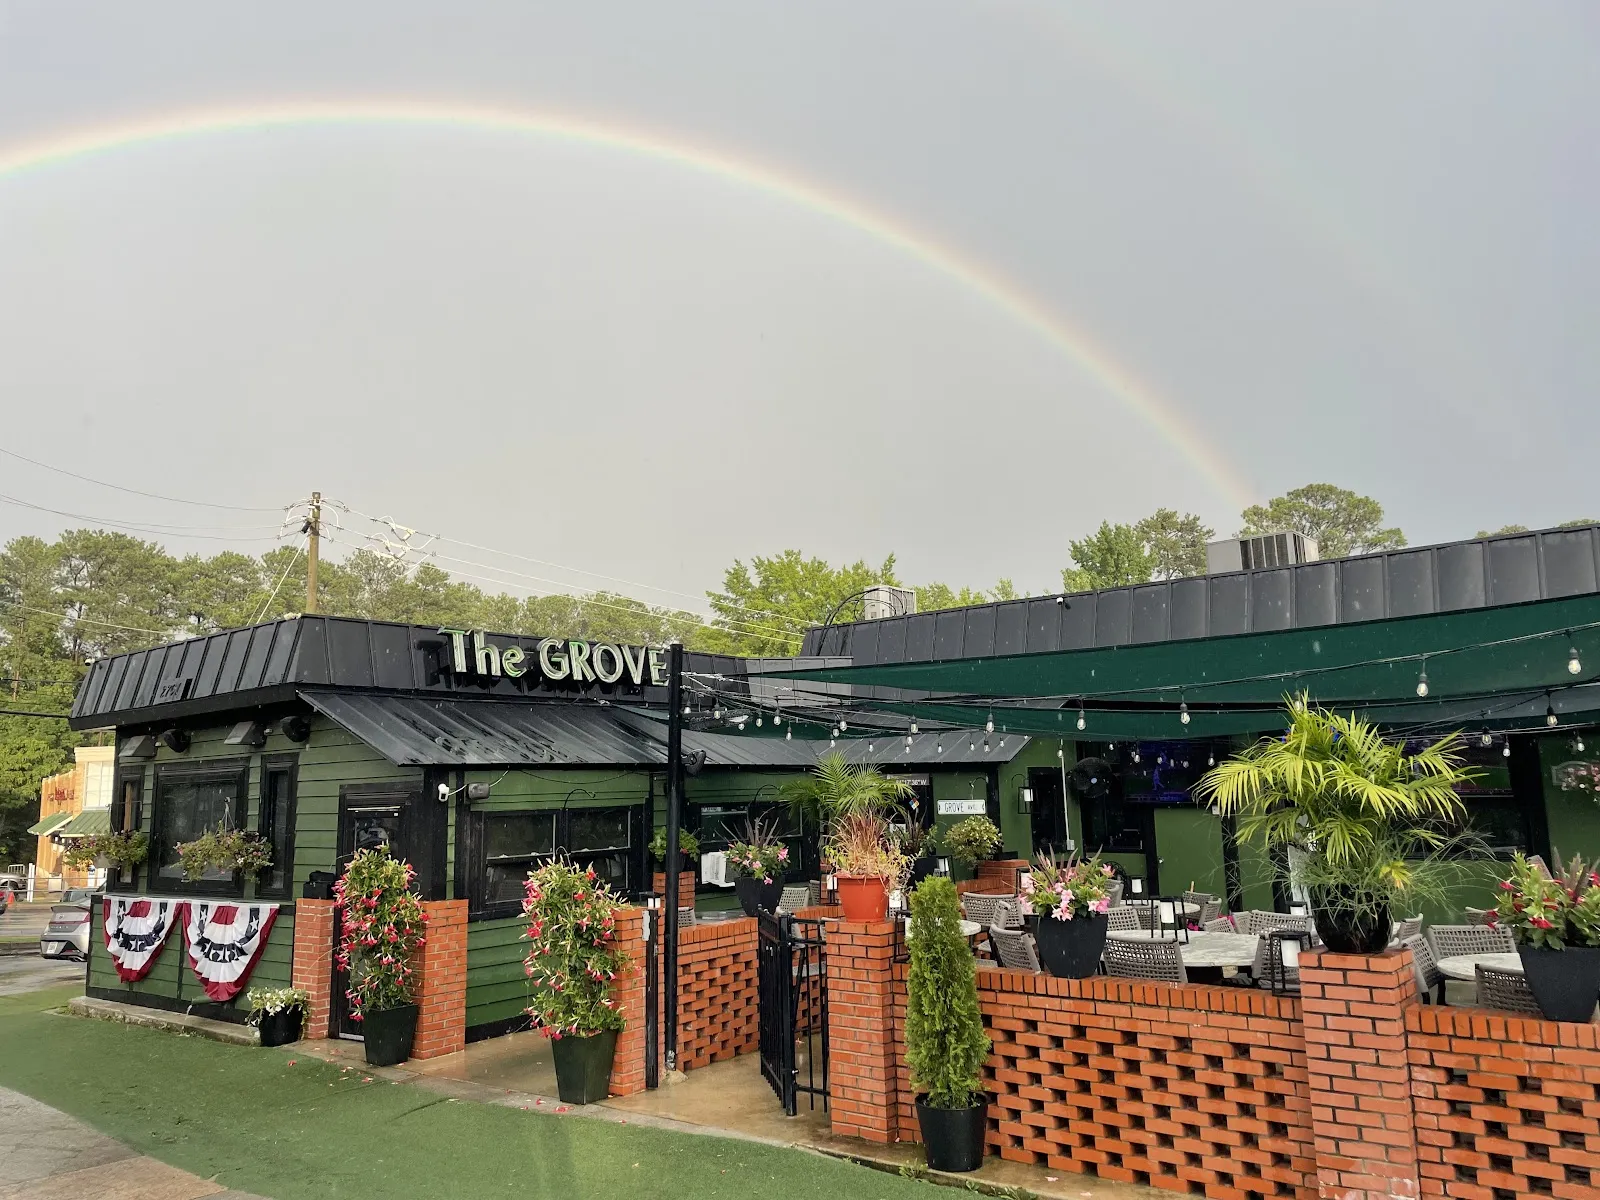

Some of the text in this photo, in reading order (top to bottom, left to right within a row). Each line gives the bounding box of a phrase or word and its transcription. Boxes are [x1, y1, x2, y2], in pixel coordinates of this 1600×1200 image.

[438, 626, 669, 686] The GROVE
[944, 802, 964, 812] GROVE
